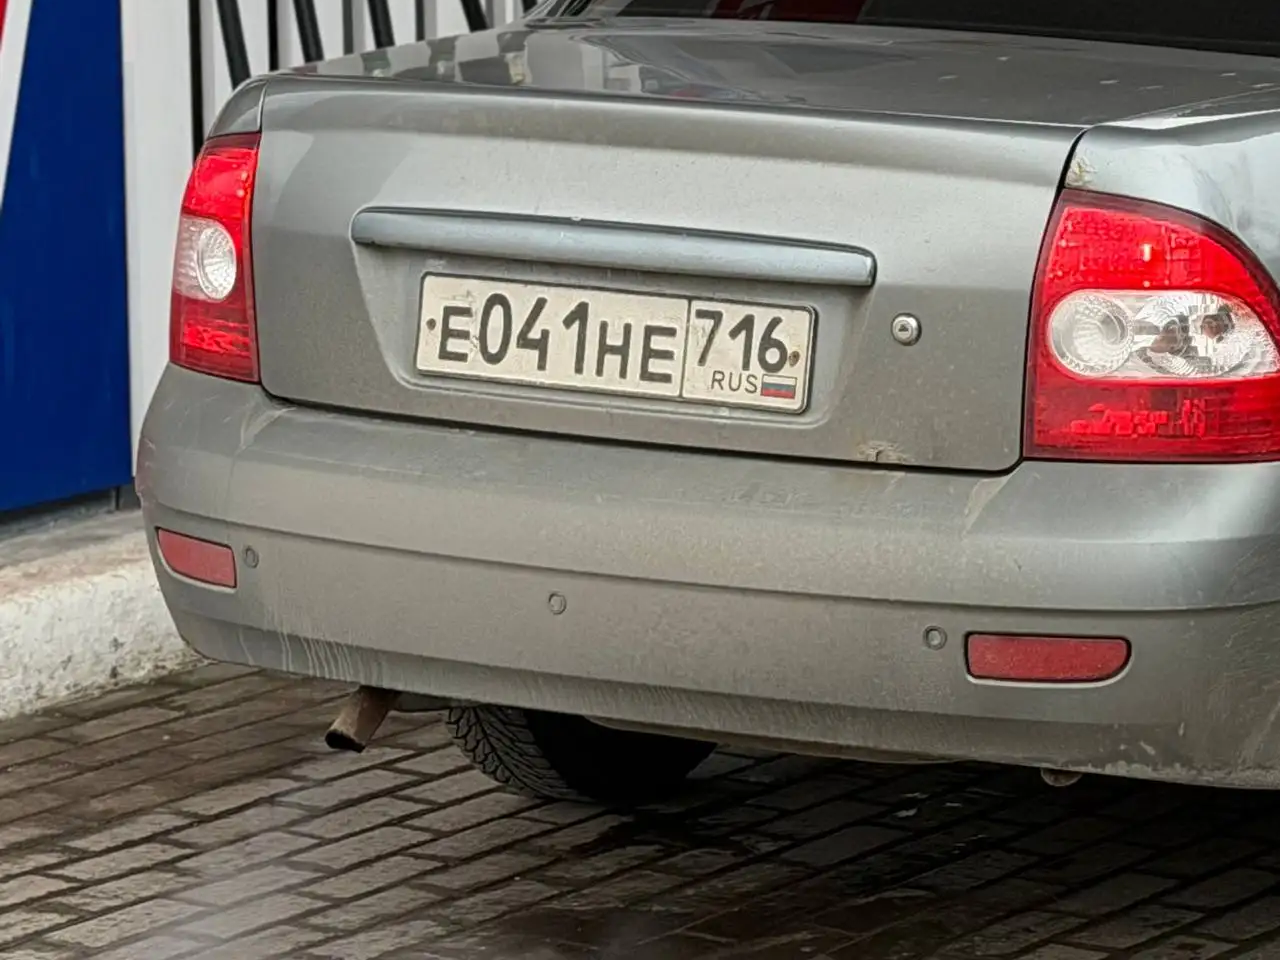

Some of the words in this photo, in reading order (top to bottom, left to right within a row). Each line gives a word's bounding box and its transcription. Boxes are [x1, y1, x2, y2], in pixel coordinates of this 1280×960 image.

[438, 293, 678, 384] Е041НЕ
[694, 308, 788, 373] 716
[711, 370, 758, 394] RUS
